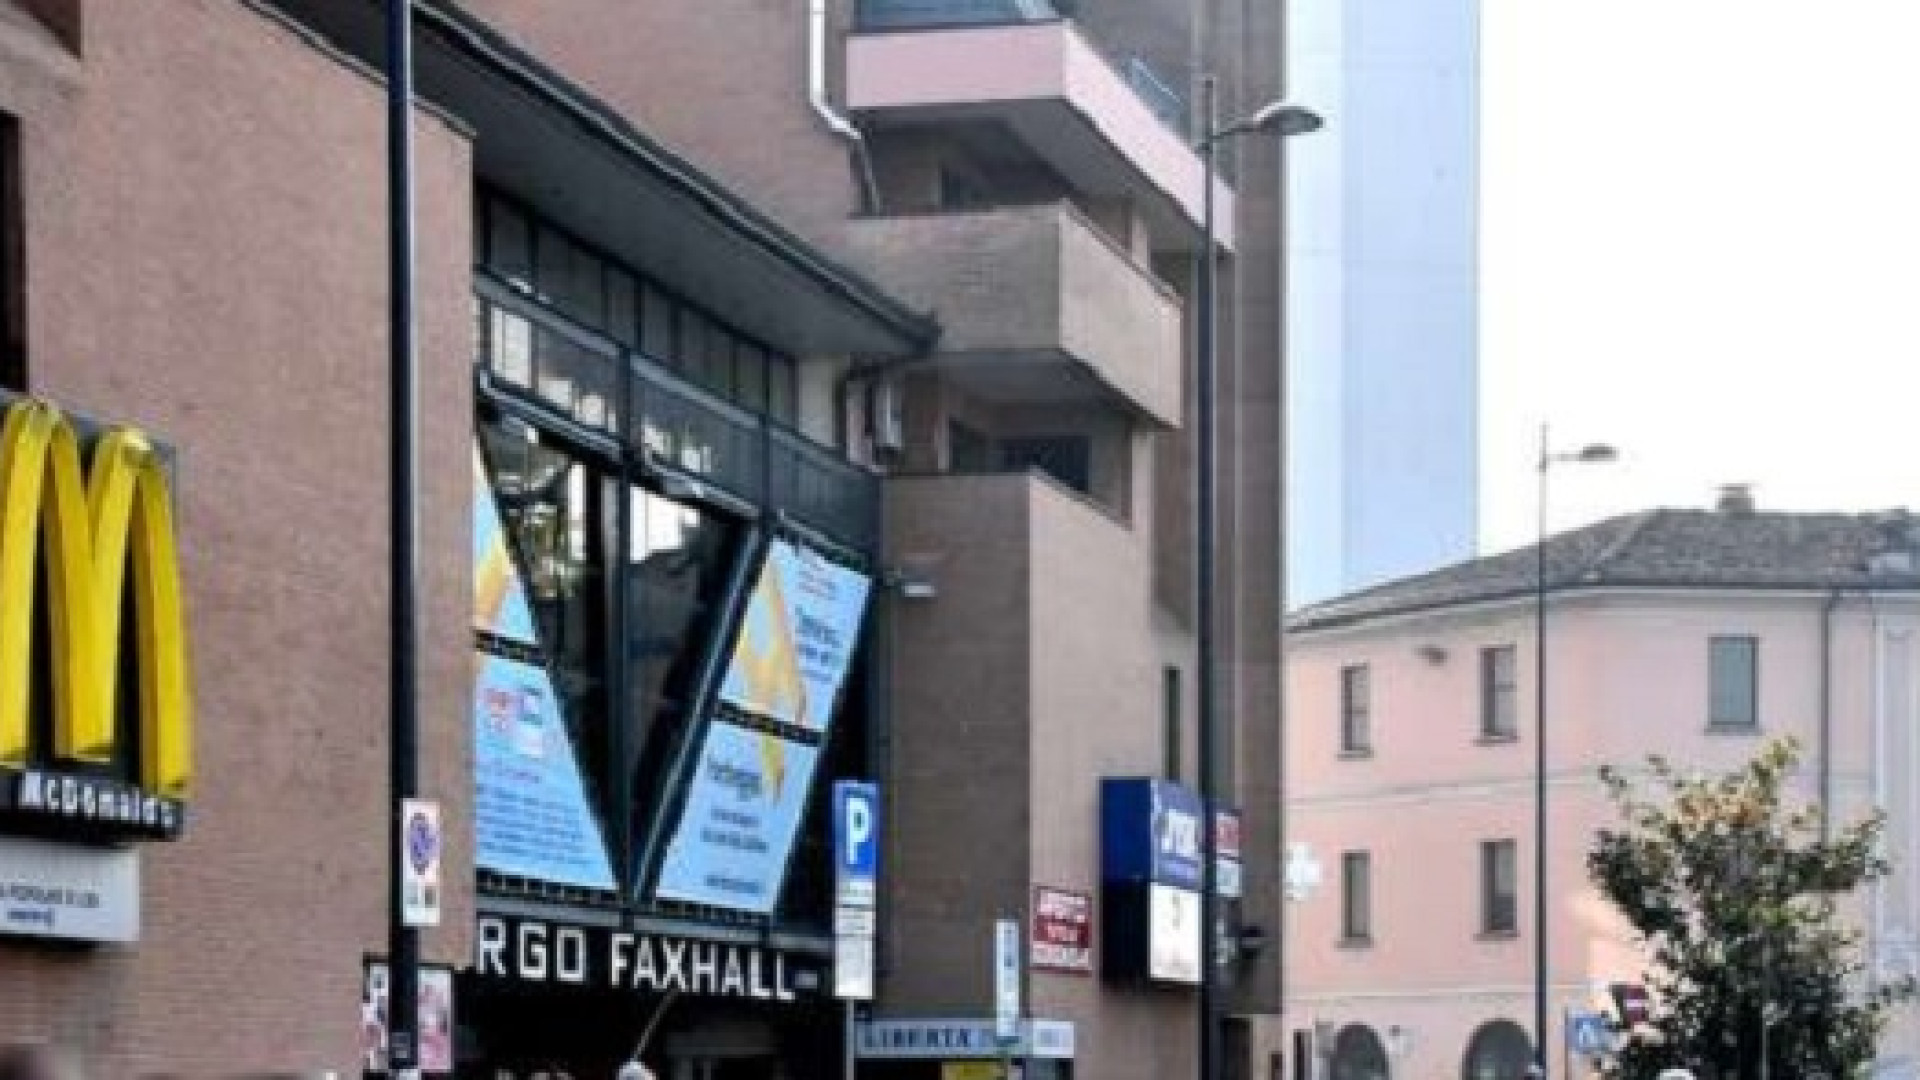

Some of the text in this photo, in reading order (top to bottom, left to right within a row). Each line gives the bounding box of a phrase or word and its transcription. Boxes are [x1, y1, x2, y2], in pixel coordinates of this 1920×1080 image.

[18, 771, 178, 828] McDonald's
[845, 796, 870, 865] P
[611, 932, 796, 1001] FAXHALL
